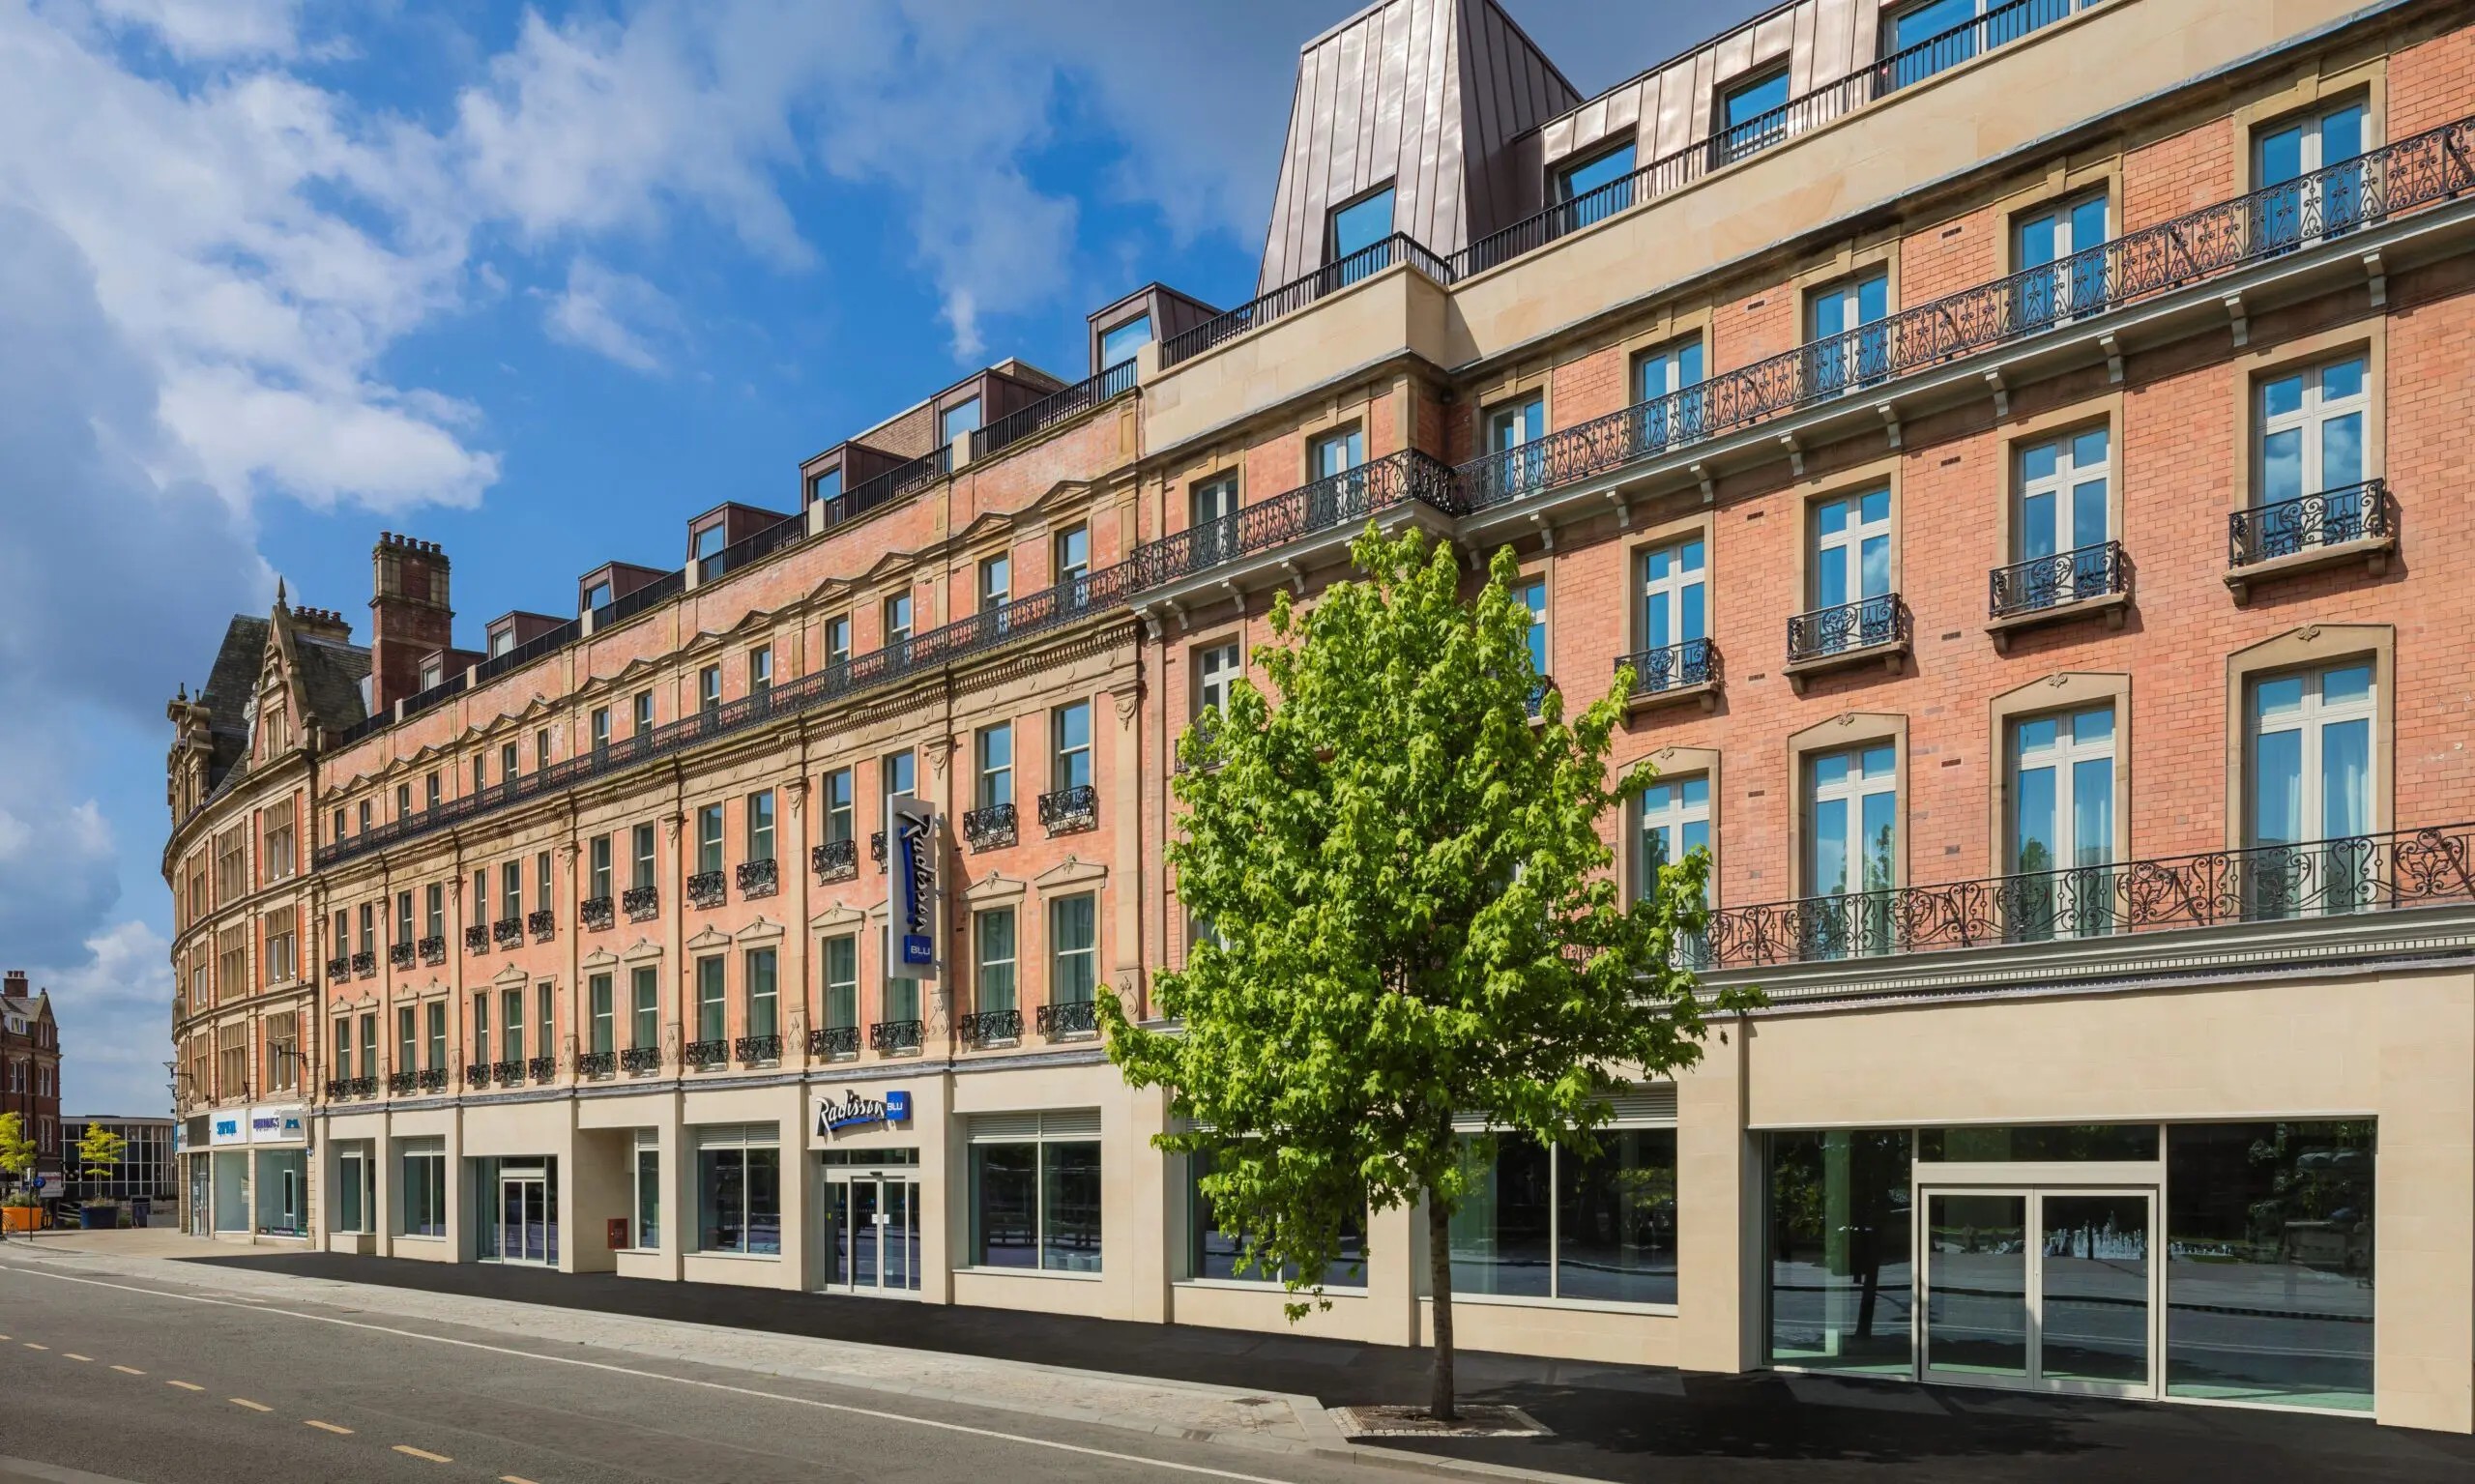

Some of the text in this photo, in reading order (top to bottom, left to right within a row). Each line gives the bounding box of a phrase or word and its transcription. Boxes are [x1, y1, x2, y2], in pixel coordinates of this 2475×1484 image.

[899, 810, 936, 933] Radisson
[910, 945, 931, 956] BLU
[814, 1090, 903, 1136] Radisson BLU
